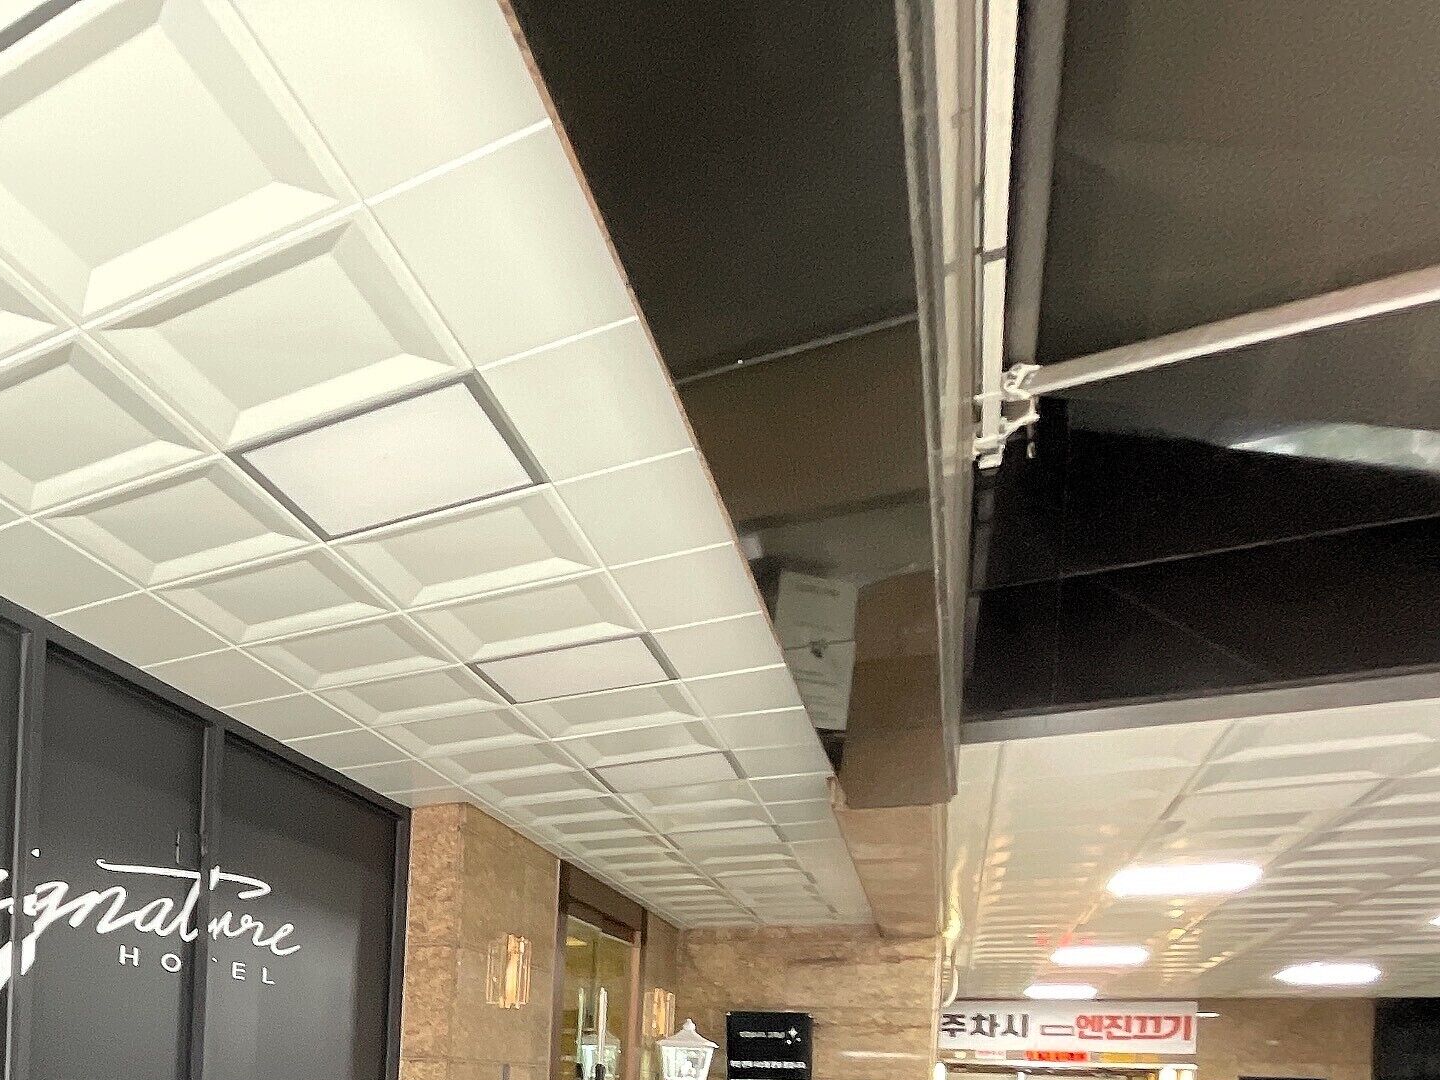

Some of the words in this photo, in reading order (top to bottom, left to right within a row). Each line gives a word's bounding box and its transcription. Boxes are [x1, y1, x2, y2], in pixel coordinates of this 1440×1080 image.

[118, 944, 277, 986] HOEL
[941, 1013, 1029, 1038] 주차시
[1075, 1014, 1193, 1041] 엔진끄기
